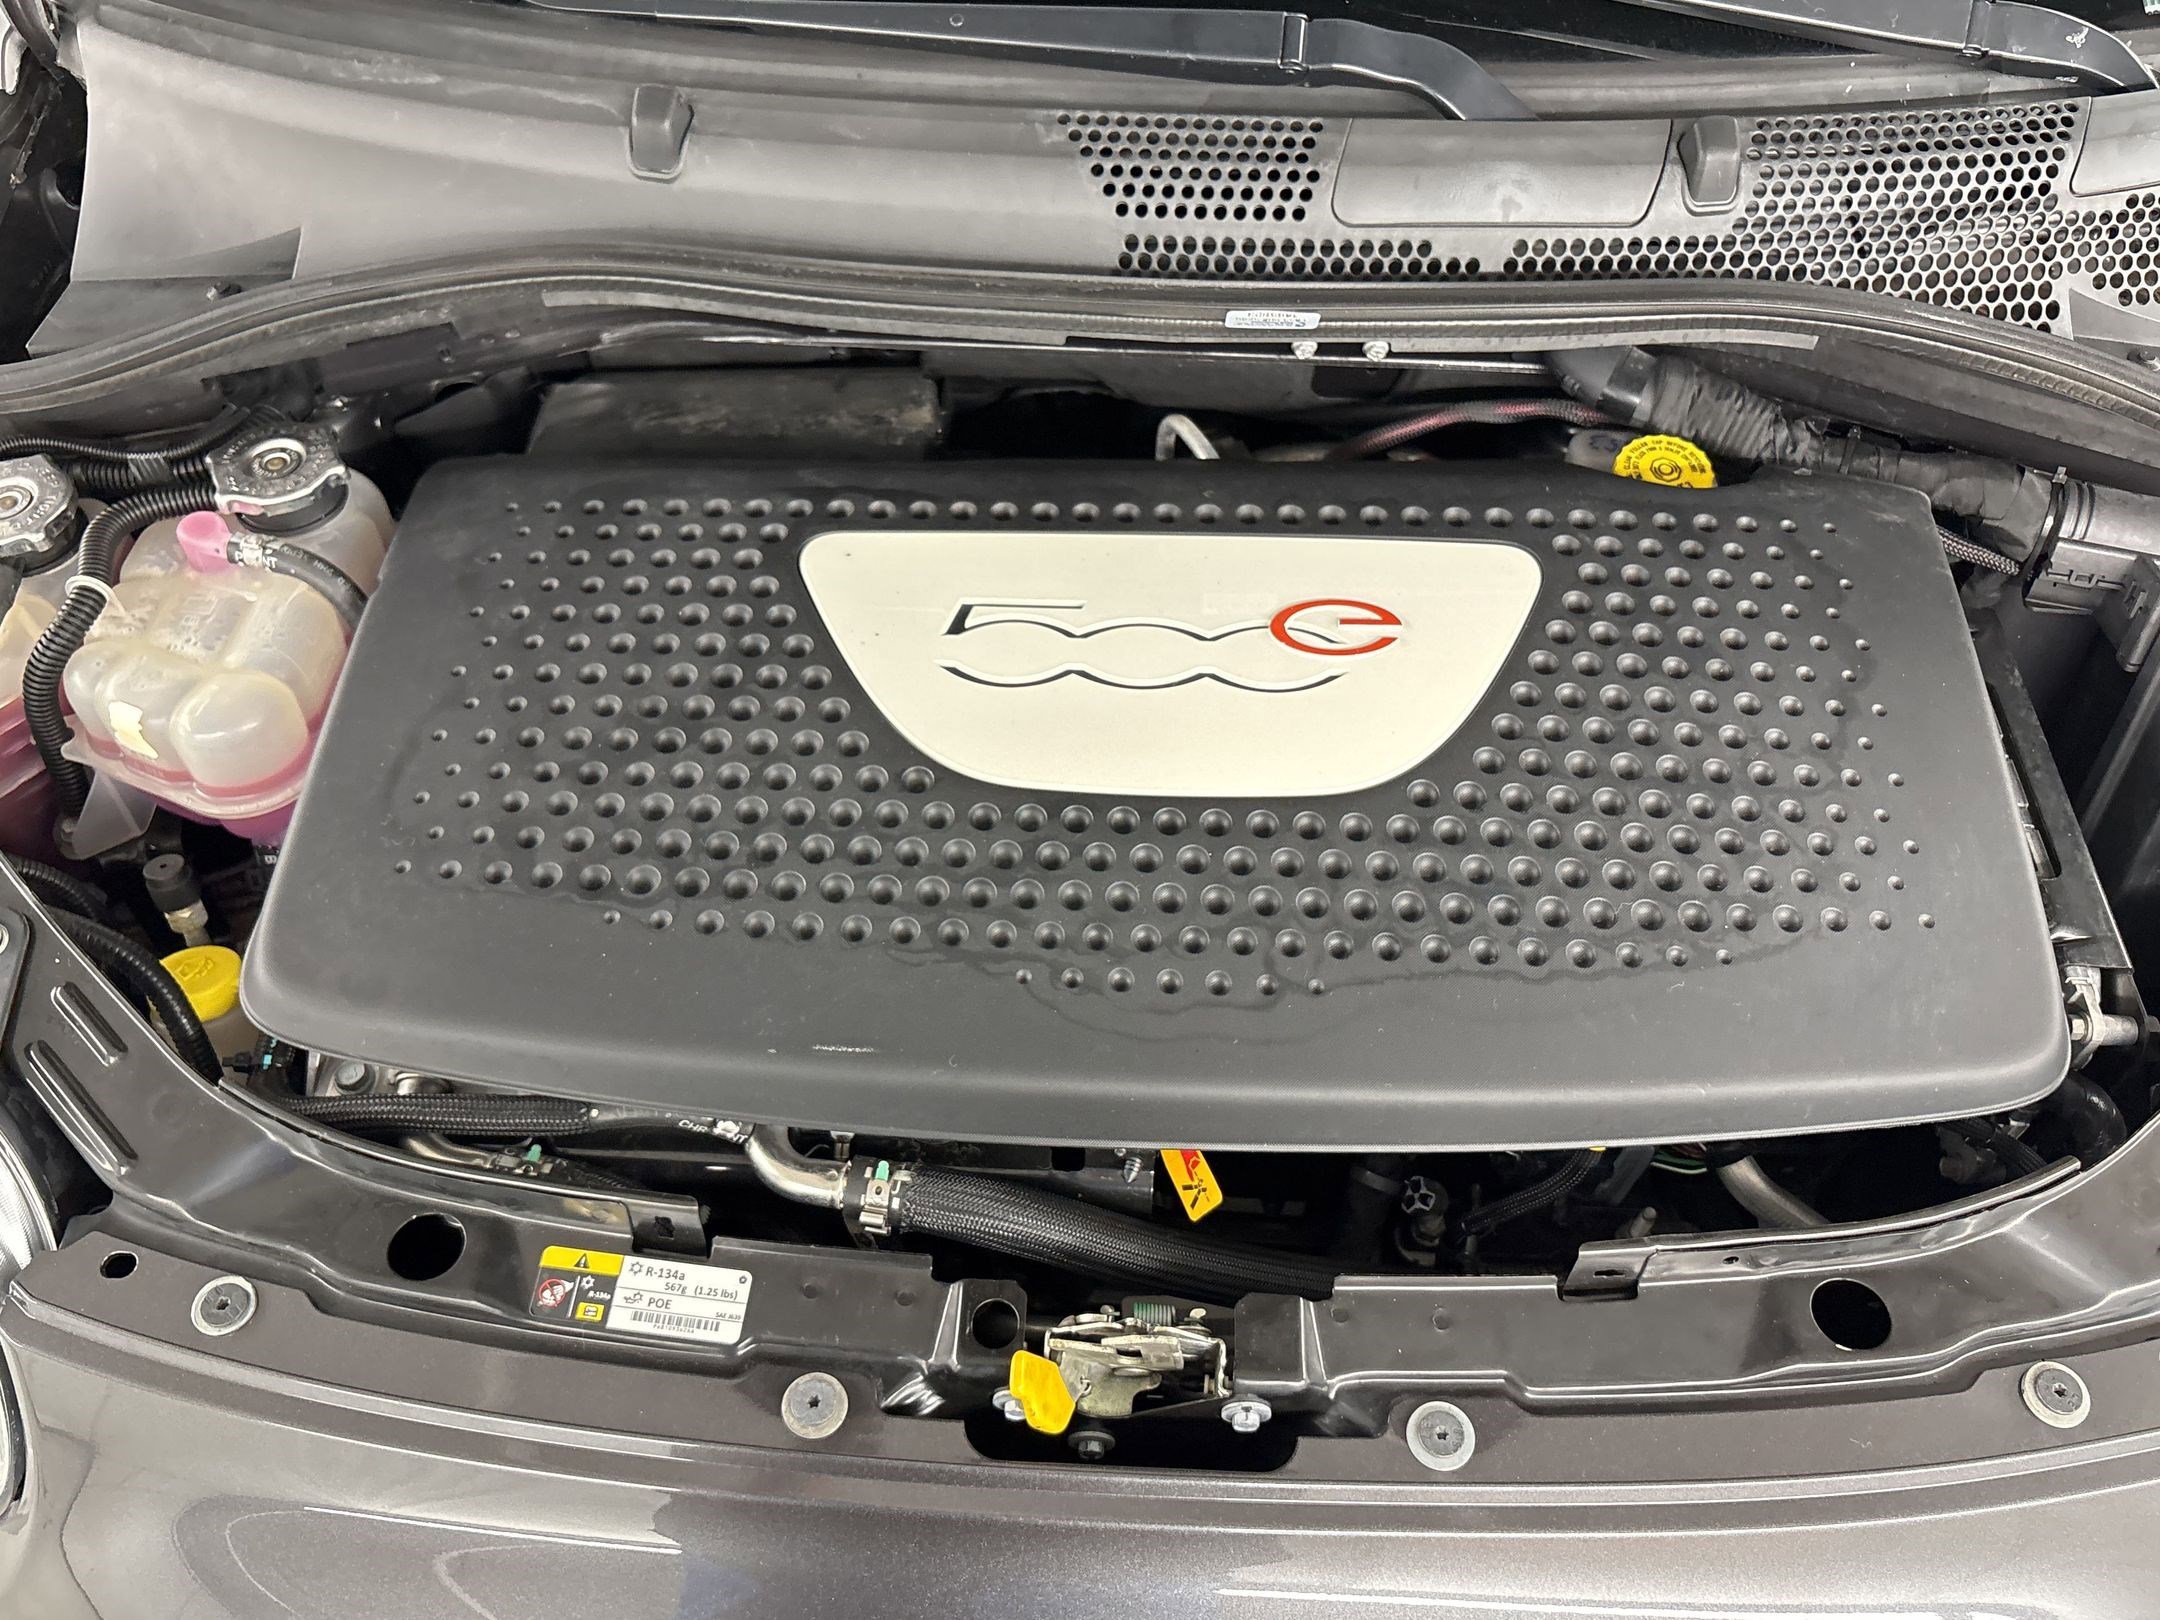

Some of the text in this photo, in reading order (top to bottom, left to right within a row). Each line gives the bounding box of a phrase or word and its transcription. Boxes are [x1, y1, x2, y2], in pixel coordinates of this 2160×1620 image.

[645, 1266, 686, 1281] R-134a
[664, 1282, 738, 1301] 567g (1.25 lbs)
[648, 1297, 673, 1310] POE
